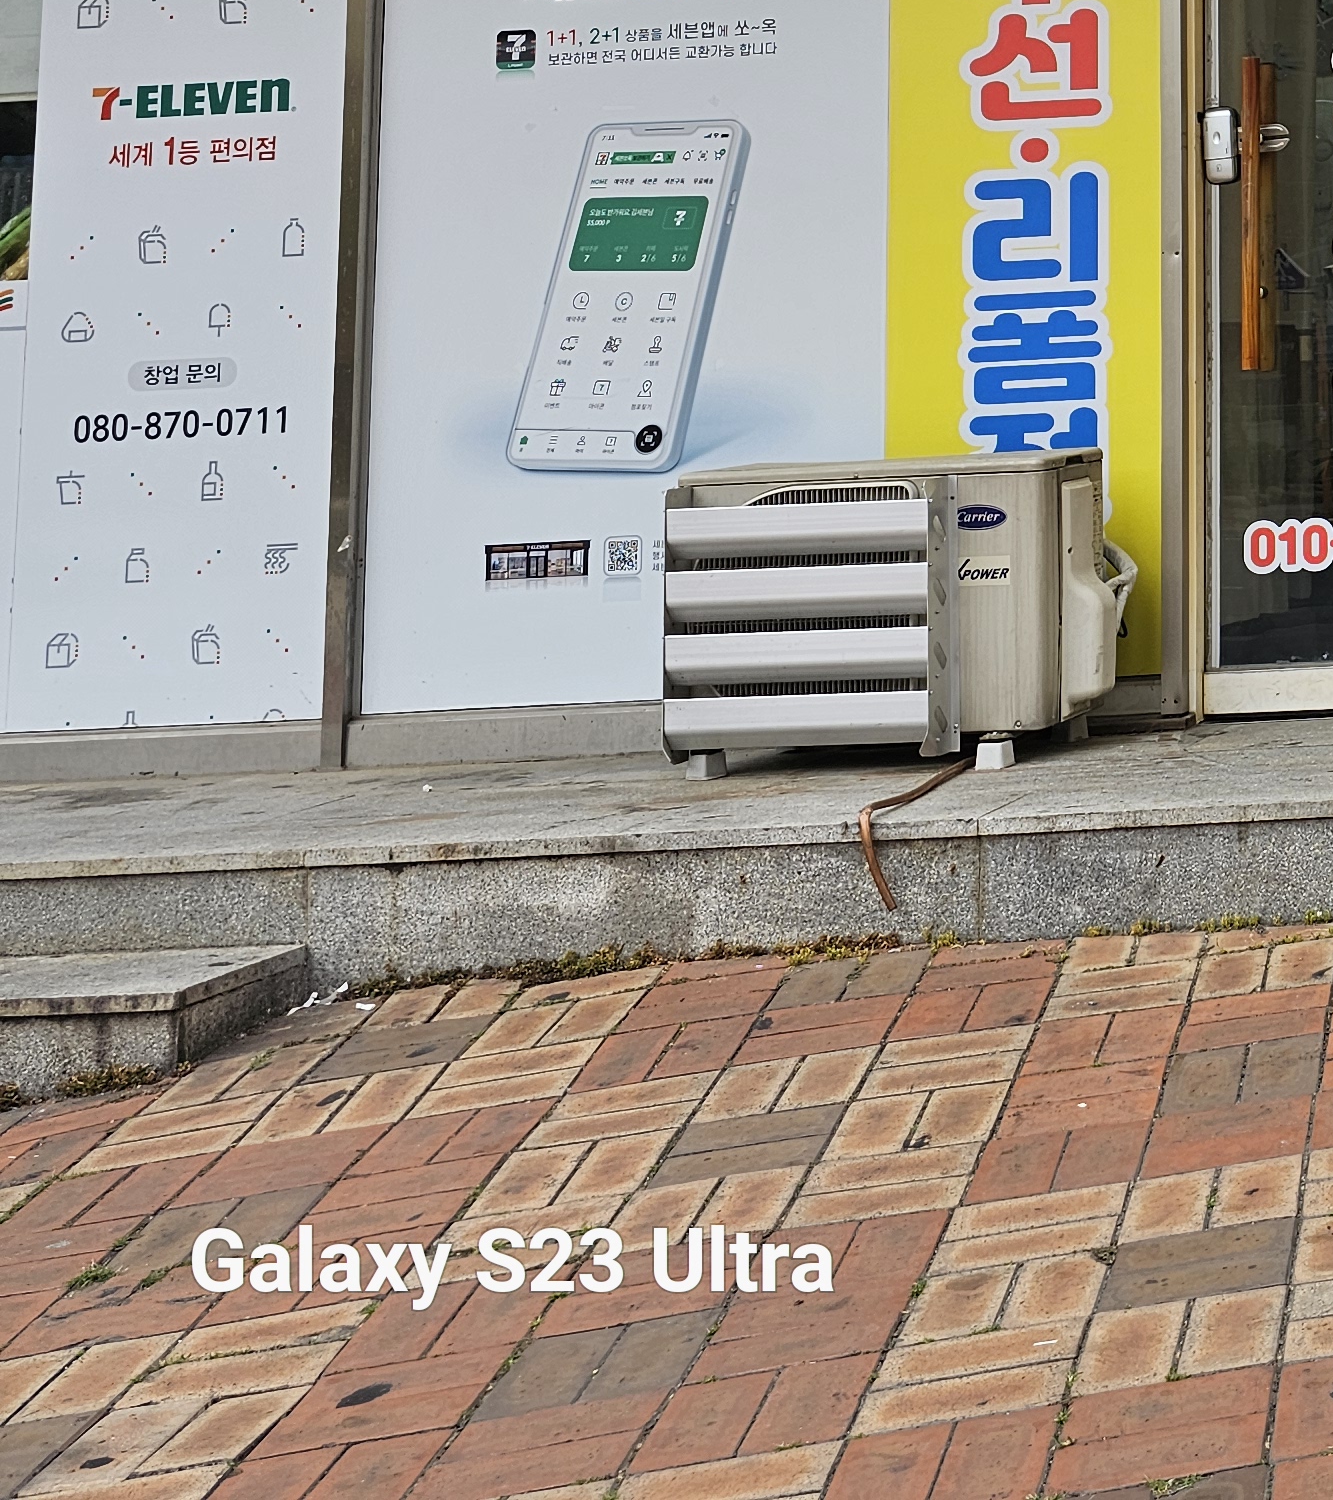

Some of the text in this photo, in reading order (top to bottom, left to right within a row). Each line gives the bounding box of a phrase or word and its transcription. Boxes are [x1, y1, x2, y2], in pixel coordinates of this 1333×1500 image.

[589, 27, 620, 45] 2+1
[625, 27, 663, 43] 상품을
[548, 41, 778, 66] 보관하면 전국 어디서든 교환가능 합니다
[108, 135, 278, 168] 세계 1등 편의점
[143, 362, 223, 386] 창업 문의
[73, 405, 290, 444] 080-870-0711
